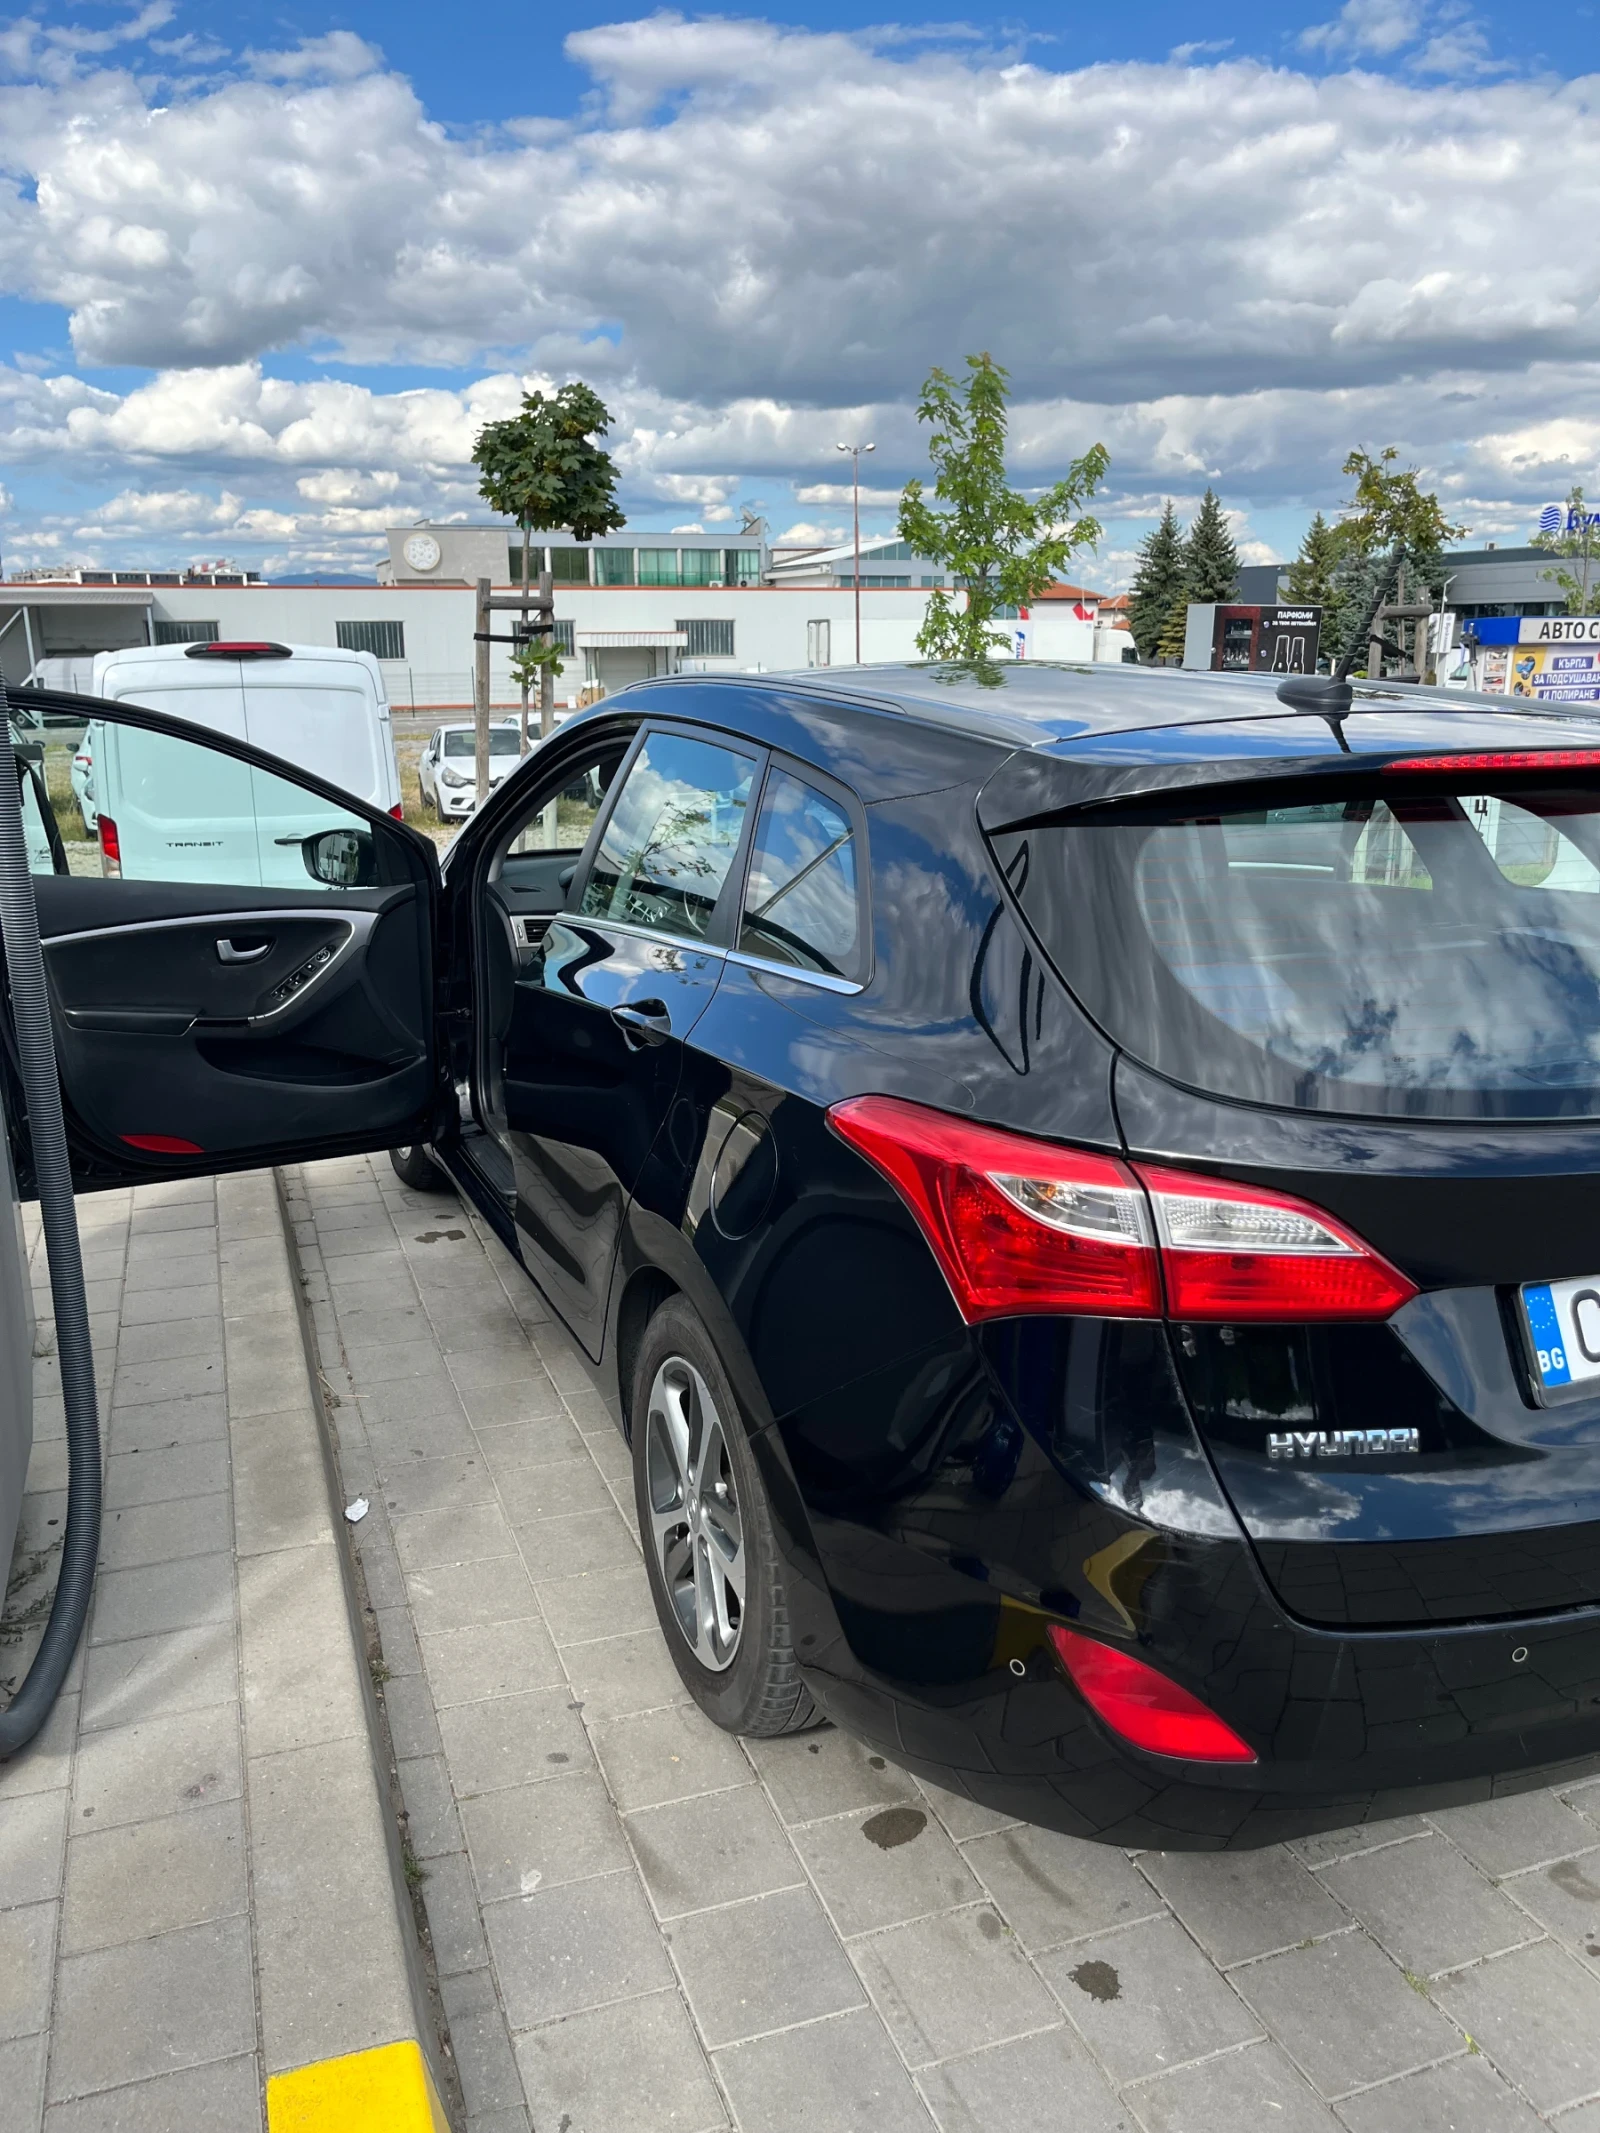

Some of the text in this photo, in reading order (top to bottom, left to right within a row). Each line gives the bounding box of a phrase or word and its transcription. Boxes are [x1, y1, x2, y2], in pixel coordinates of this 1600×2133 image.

[1277, 611, 1313, 619] ПАРФЮМИ
[1539, 622, 1600, 639] АВТО С
[1558, 657, 1587, 669] КЪРПА
[1533, 674, 1544, 684] ЗА
[1543, 688, 1595, 700] И ПОЛИРАНЕ
[1537, 1347, 1565, 1373] BG
[1268, 1427, 1419, 1459] HYUNDAI
